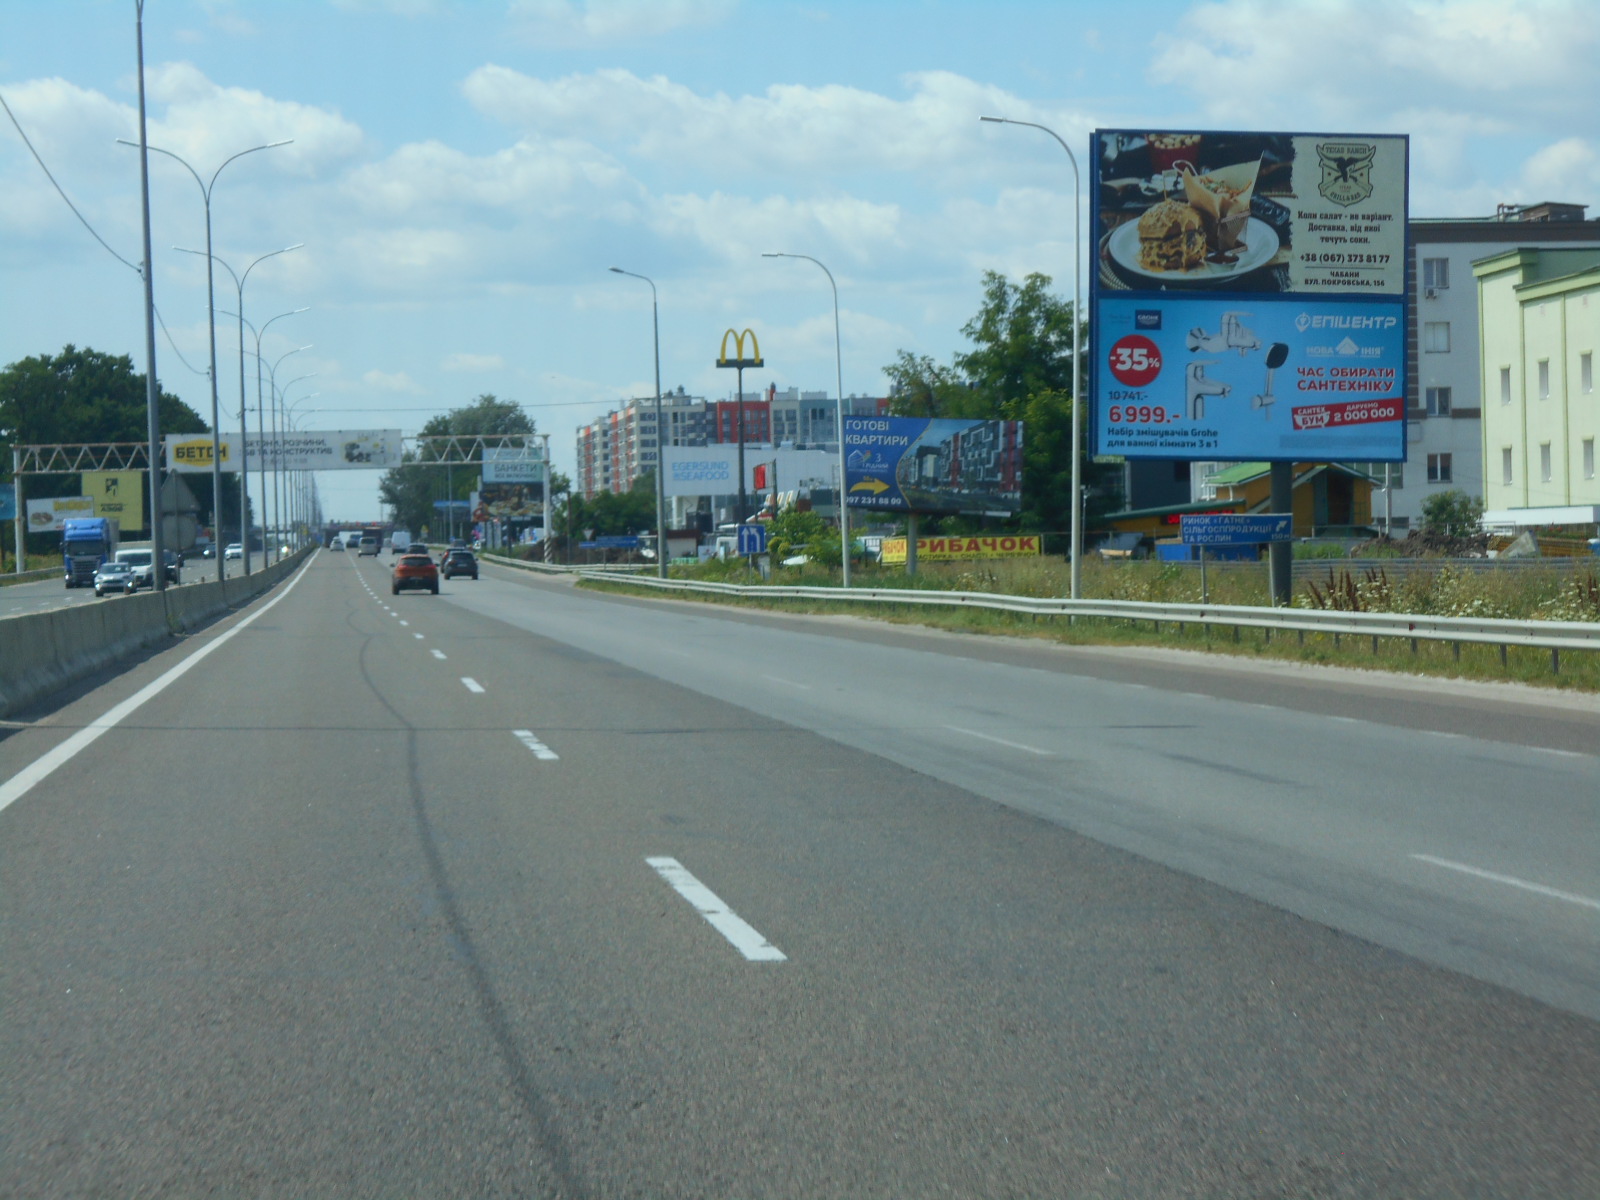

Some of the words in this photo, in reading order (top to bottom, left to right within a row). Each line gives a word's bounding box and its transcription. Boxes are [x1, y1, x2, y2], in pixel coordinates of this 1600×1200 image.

[1297, 211, 1318, 220] Коли
[1319, 213, 1343, 221] салат
[1308, 223, 1348, 233] Доставка,
[1350, 224, 1362, 233] від
[1364, 224, 1381, 232] якої
[1320, 236, 1348, 245] течуть
[1300, 253, 1317, 262] +38
[1319, 253, 1345, 264] (067)
[1347, 254, 1364, 263] 373
[1304, 278, 1321, 286] ВУЛ.
[1321, 279, 1372, 287] ПОКРОВСЬКА,
[1312, 315, 1397, 329] ЕПІЦЕНТР
[1297, 367, 1325, 377] ЧАС
[1330, 367, 1396, 379] ОБИРАТИ
[1297, 379, 1395, 392] САНТЕХНІКУ
[1298, 407, 1326, 416] САНТЕХ
[846, 420, 889, 431] ГОТОВІ
[1302, 416, 1325, 426] БУМ
[1107, 427, 1134, 437] Набір
[1136, 428, 1189, 438] змішувачів
[1190, 428, 1219, 437] Grohe
[845, 434, 908, 446] КВАРТИРИ
[1107, 439, 1126, 448] для
[1127, 439, 1158, 448] ванної
[1159, 439, 1197, 448] кімнати
[495, 463, 537, 472] БАНКЕТИ
[680, 471, 729, 480] SEAFOOD
[1183, 516, 1211, 525] РИНОК
[1183, 524, 1272, 534] СІЛЬГОСППРОДУКЦІЇ
[1184, 535, 1196, 543] ТА
[1197, 534, 1232, 542] РОСЛИН
